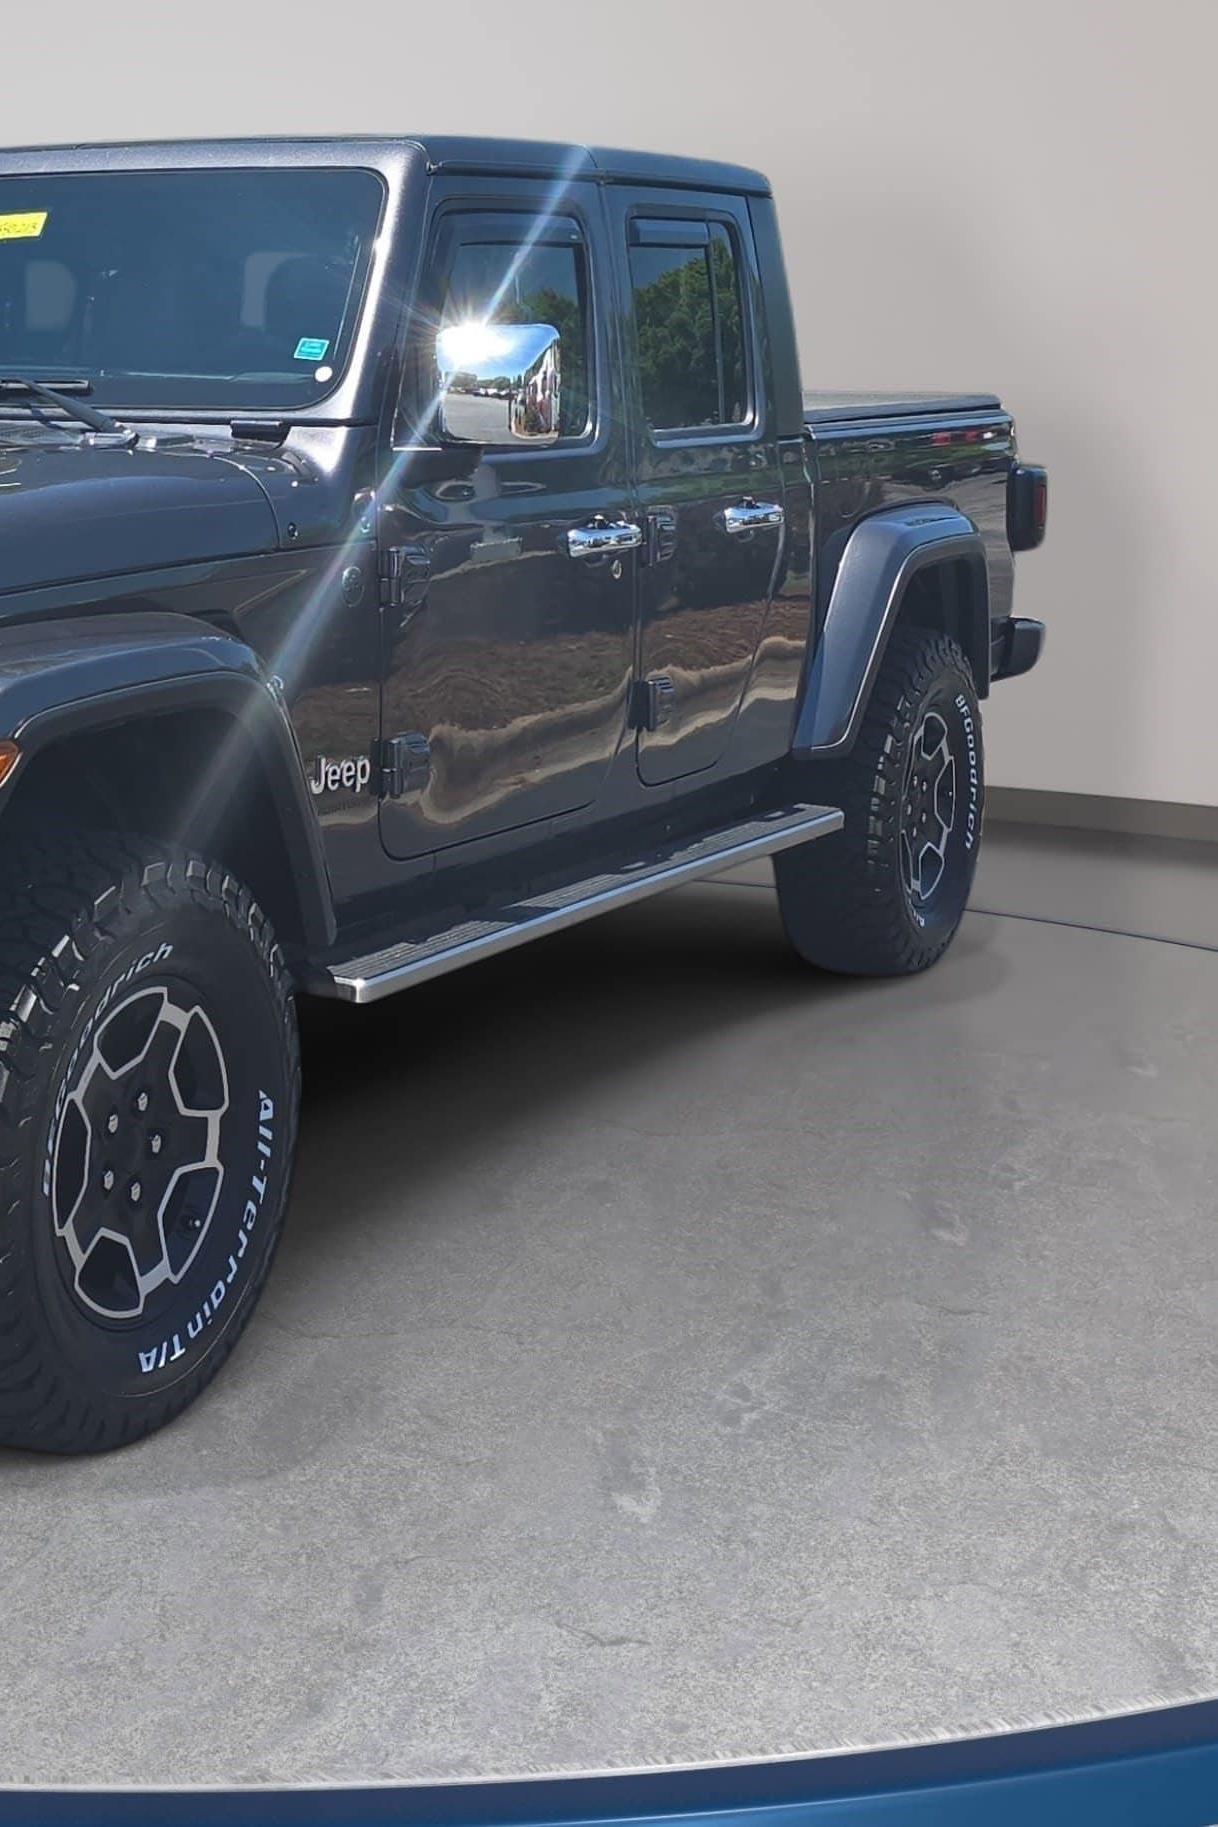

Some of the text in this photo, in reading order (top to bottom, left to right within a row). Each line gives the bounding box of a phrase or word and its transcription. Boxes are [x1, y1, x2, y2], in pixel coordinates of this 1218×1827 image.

[310, 756, 371, 794] Jeep
[138, 1089, 274, 1373] All-Terrain T/A
